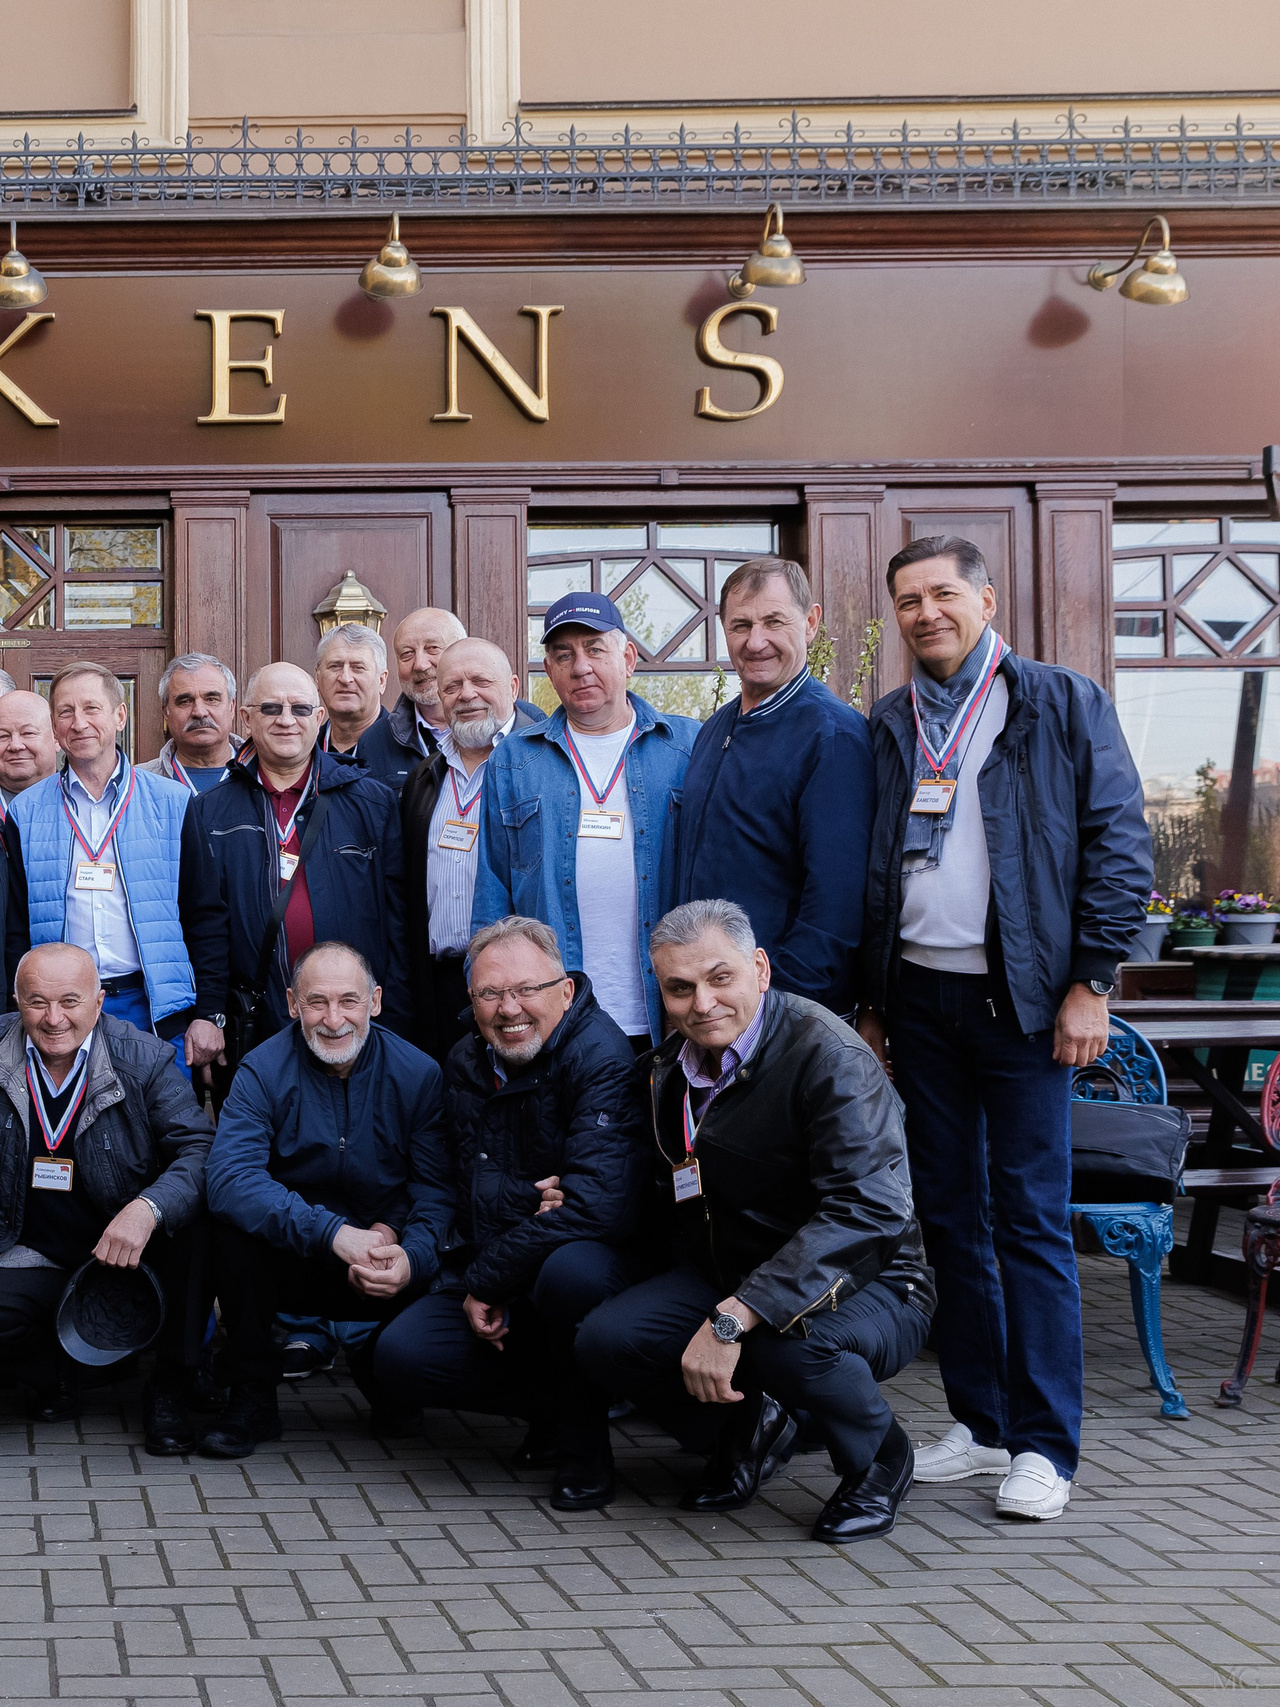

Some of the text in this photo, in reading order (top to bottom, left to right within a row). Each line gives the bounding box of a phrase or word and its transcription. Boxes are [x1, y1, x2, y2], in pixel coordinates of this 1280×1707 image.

[550, 607, 601, 624] TOMMY HILFIGER
[34, 1173, 68, 1182] РЫБИНСКОВ
